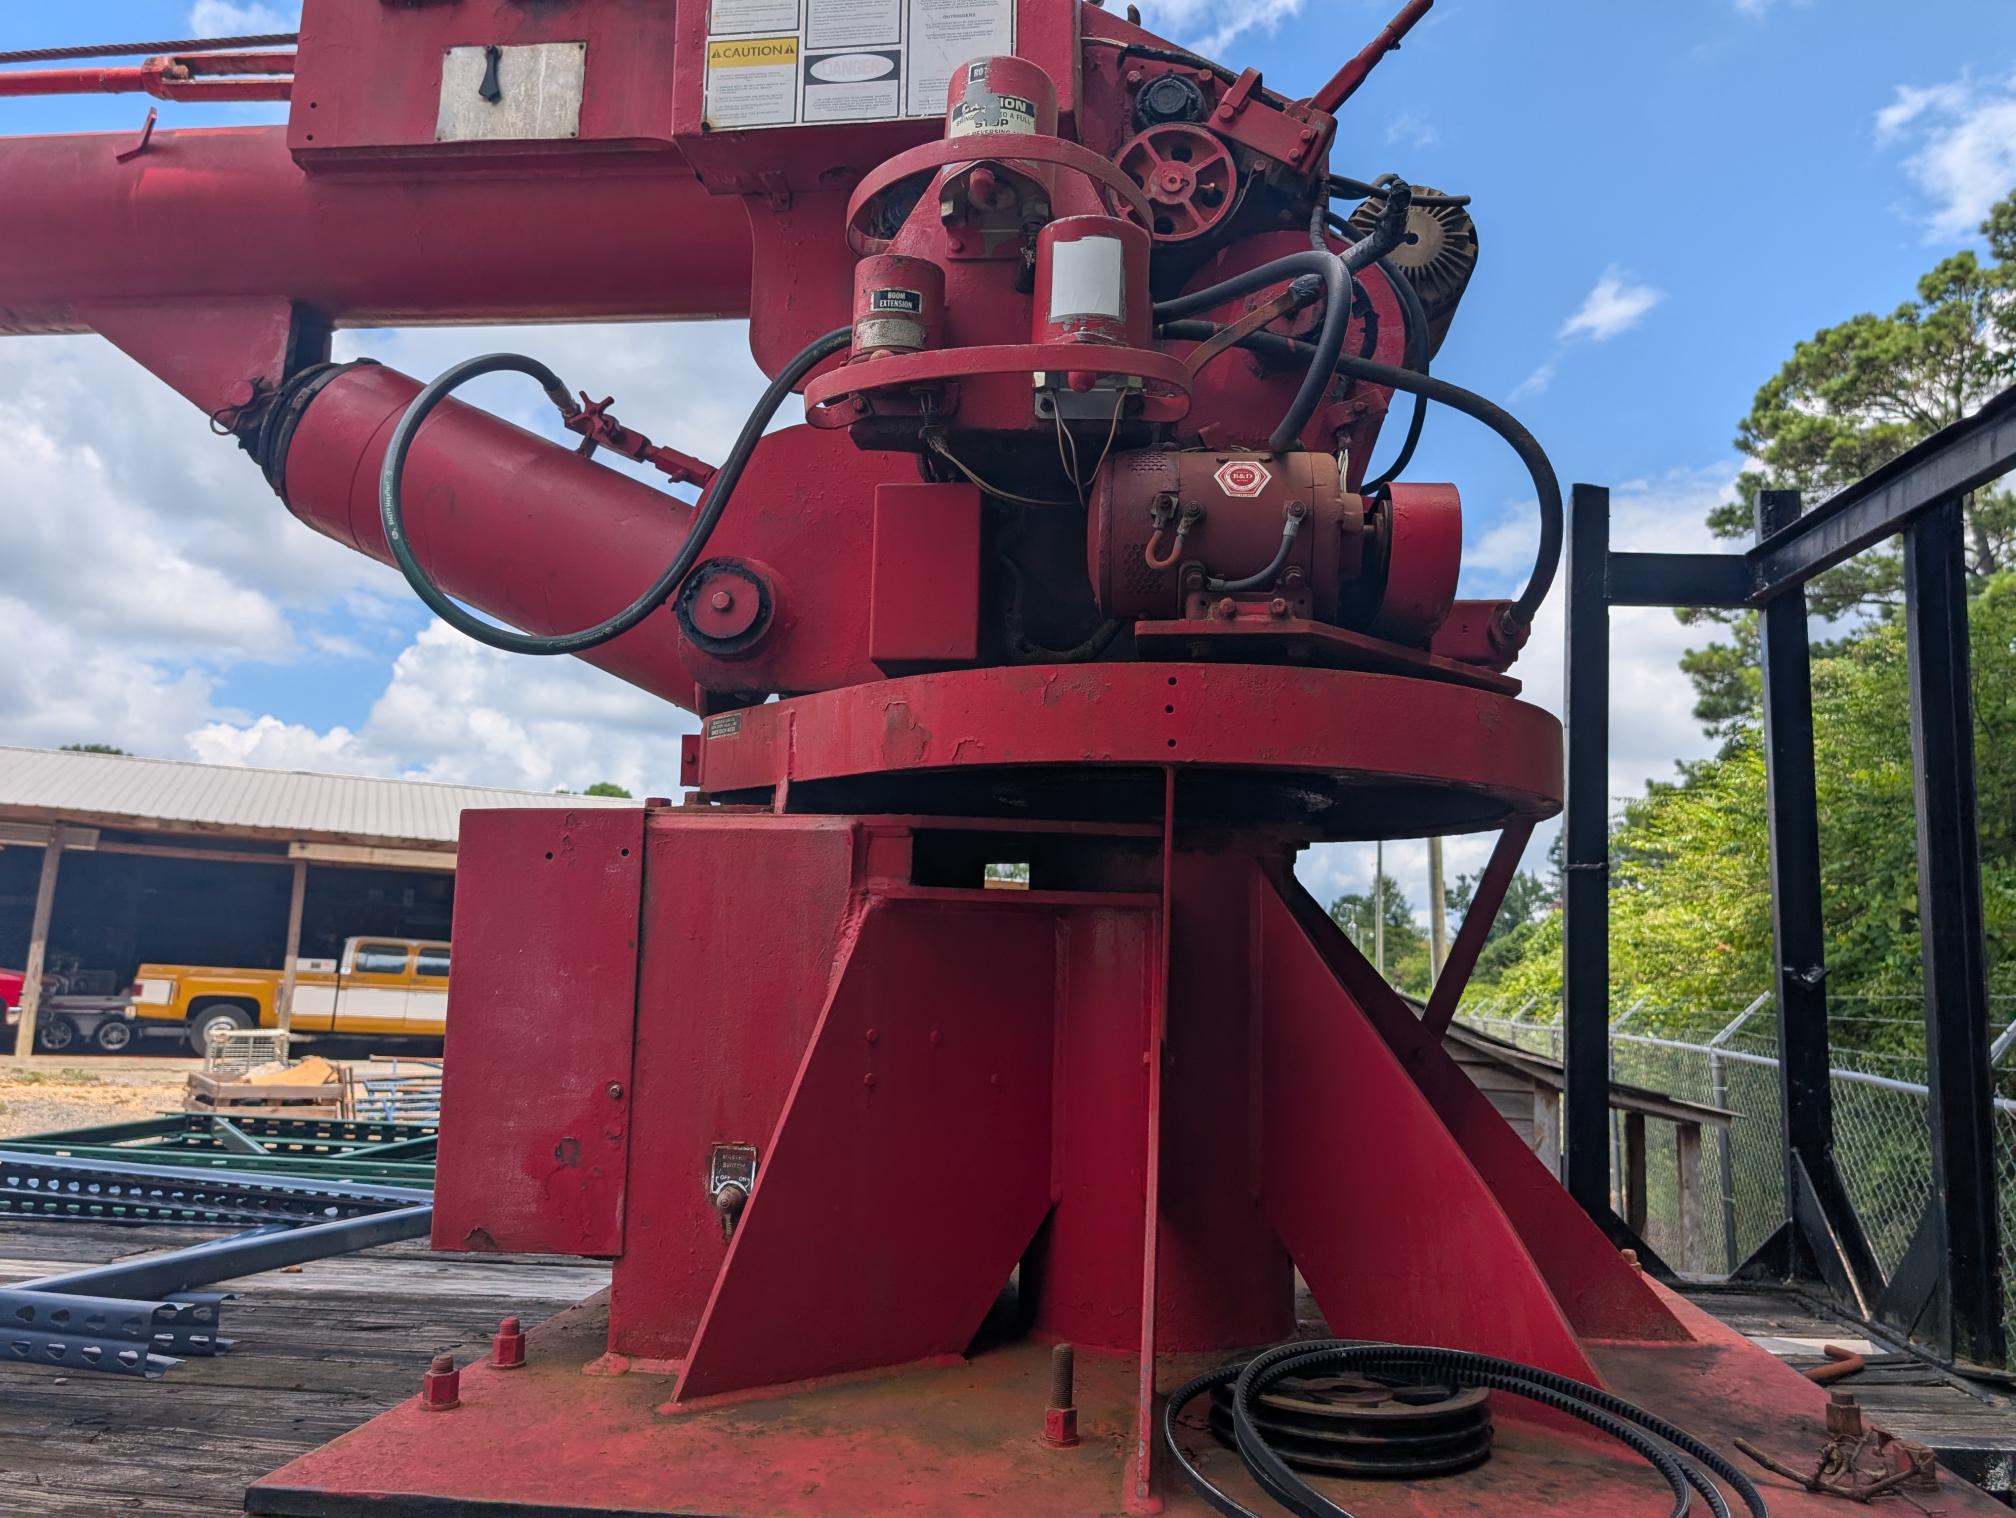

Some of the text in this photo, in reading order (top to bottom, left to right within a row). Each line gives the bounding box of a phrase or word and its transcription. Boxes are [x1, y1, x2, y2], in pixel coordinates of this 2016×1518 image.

[722, 44, 783, 58] CAUTION
[821, 57, 881, 77] DANGER
[1016, 114, 1031, 126] FULL
[888, 292, 905, 300] BOOM
[880, 300, 912, 309] EXTENSION
